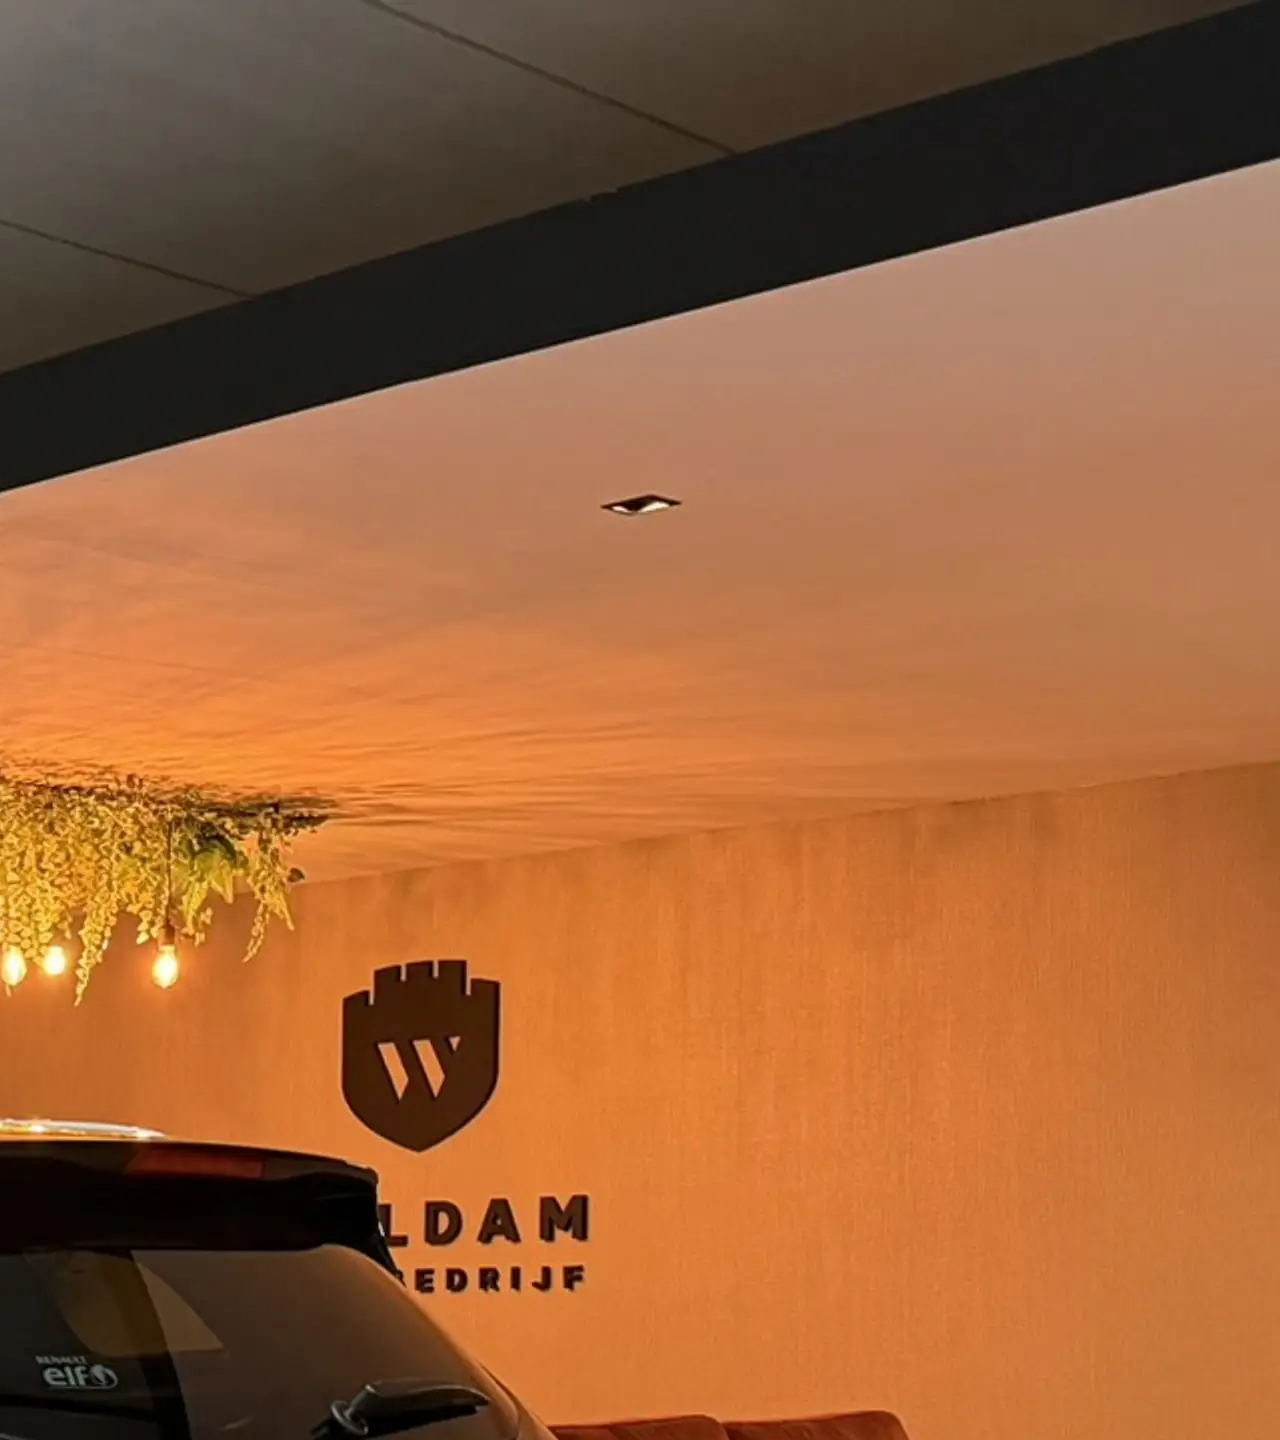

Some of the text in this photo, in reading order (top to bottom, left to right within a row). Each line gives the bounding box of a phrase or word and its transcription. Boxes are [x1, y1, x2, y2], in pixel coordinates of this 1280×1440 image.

[378, 1194, 588, 1247] LDAM
[398, 1264, 585, 1293] EDRIJF
[42, 1365, 88, 1386] elf
